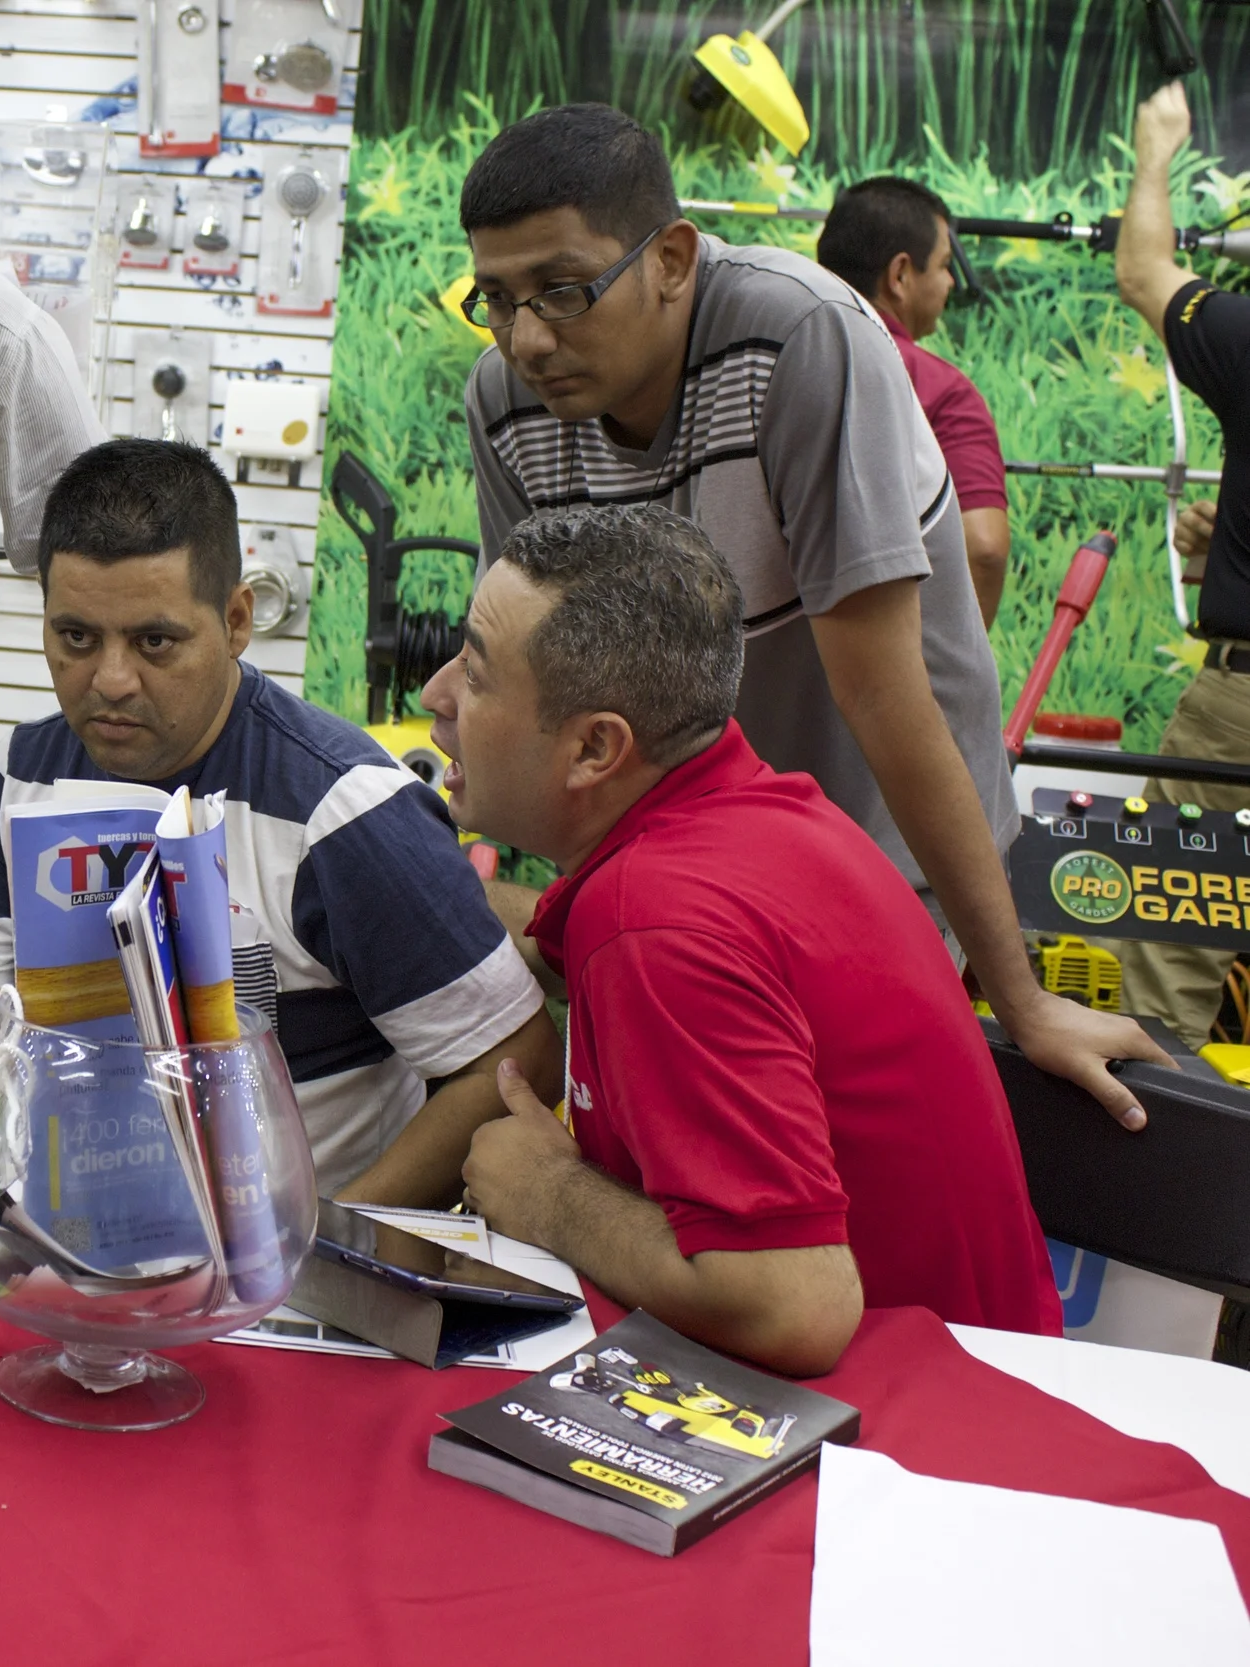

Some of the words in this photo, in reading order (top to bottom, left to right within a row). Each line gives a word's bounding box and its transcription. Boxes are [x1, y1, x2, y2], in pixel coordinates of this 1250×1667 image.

[97, 832, 131, 843] tuercas
[132, 832, 138, 842] y
[1064, 856, 1115, 875] FOREST
[1062, 875, 1122, 899] PRO
[72, 895, 83, 905] LA
[84, 892, 114, 903] REVISTA
[1069, 901, 1116, 918] GARDEN
[1133, 894, 1250, 931] GAR
[71, 1141, 165, 1174] dieron
[559, 1416, 600, 1437] CATALOG
[501, 1402, 718, 1494] HERRAMIENTAS
[601, 1433, 630, 1449] TOOLS
[630, 1444, 674, 1464] AMERICA
[673, 1459, 701, 1475] LATIN
[581, 1464, 677, 1504] STANLEY
